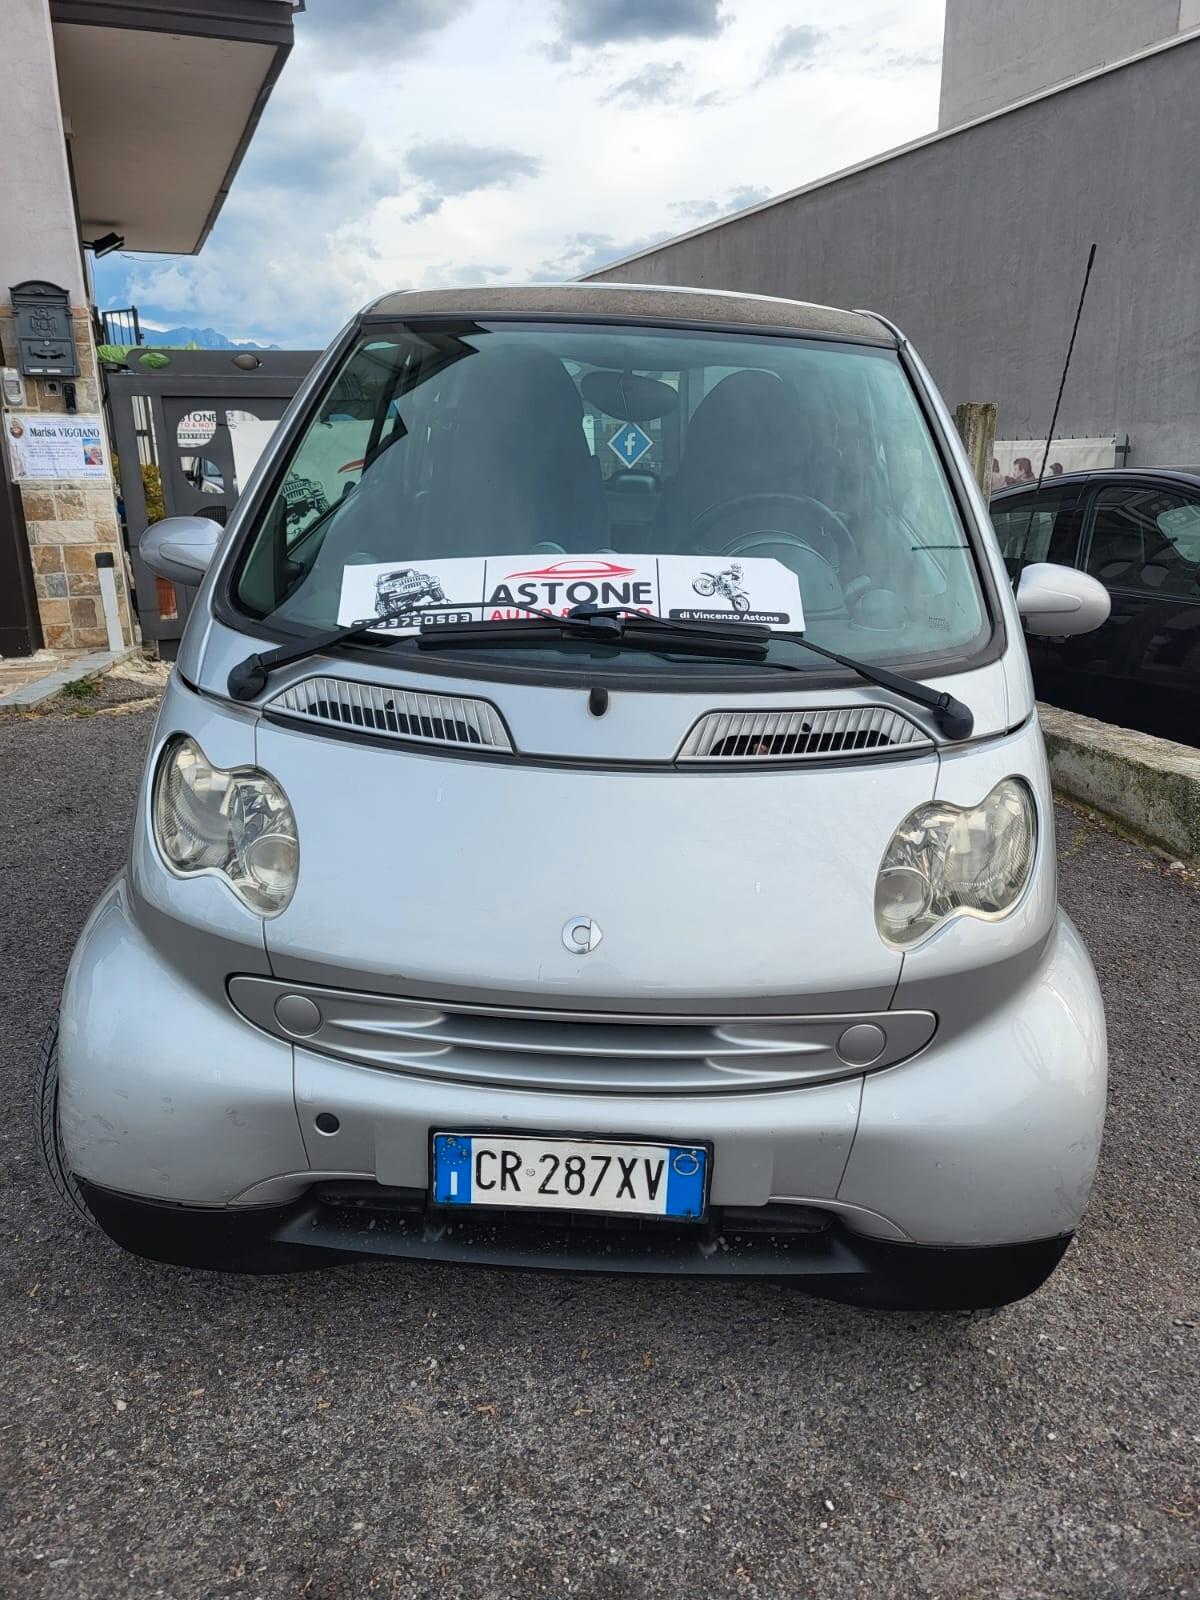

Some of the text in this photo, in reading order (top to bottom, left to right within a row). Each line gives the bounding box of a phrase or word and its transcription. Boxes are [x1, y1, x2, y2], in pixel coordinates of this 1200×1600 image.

[29, 427, 100, 438] Marisa VIGGIANO
[490, 582, 654, 606] ASTONE
[353, 613, 471, 629] 33720583
[679, 611, 780, 622] di Vincenzo Astone
[475, 1149, 665, 1201] CR 287XV
